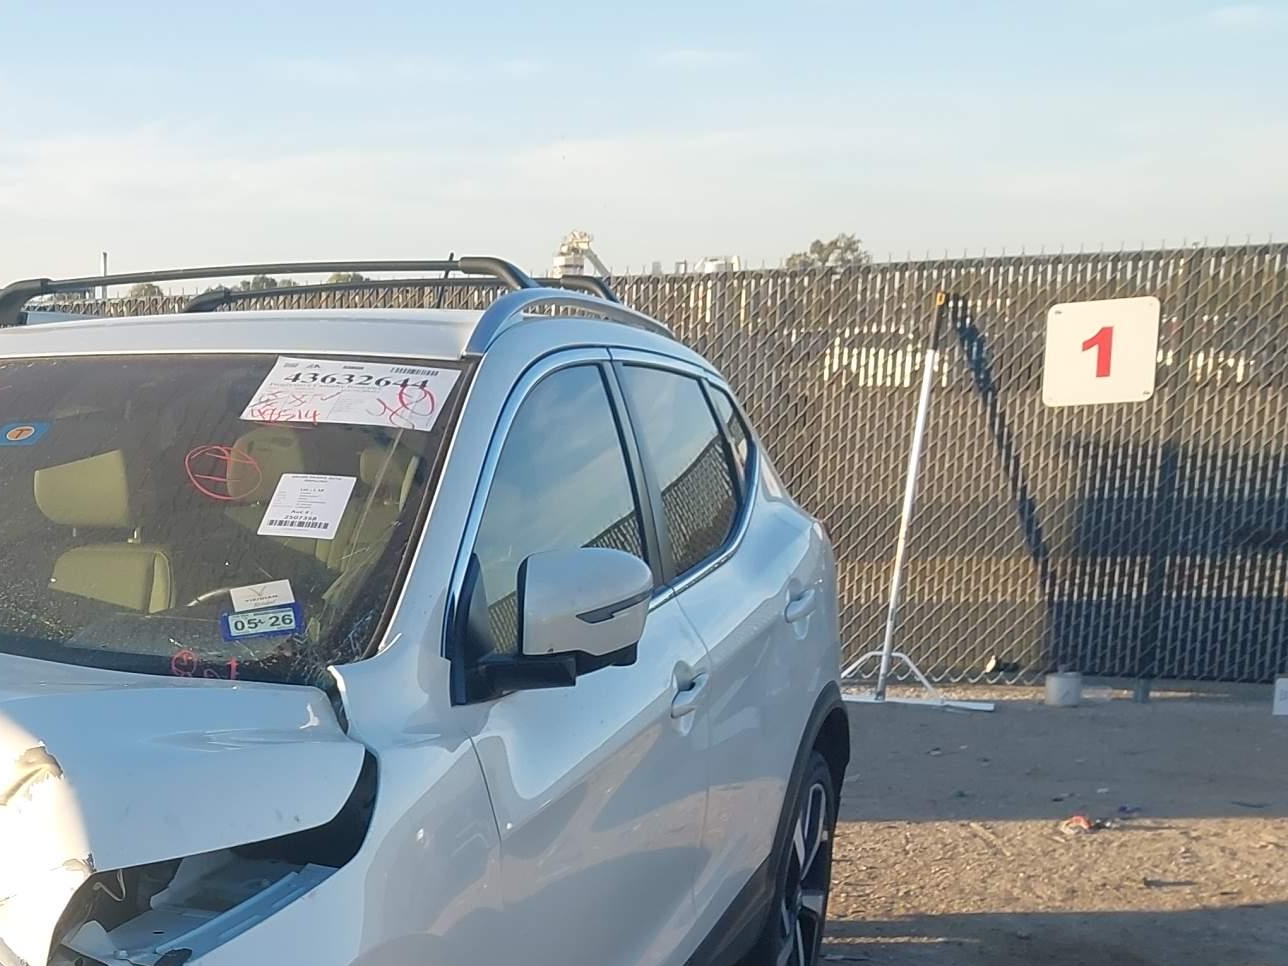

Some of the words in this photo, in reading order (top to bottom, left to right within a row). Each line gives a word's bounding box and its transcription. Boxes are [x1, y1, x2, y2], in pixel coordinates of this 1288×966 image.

[1082, 326, 1113, 378] 1
[284, 372, 430, 389] 43632644
[234, 618, 258, 631] 05
[269, 614, 293, 627] 26
